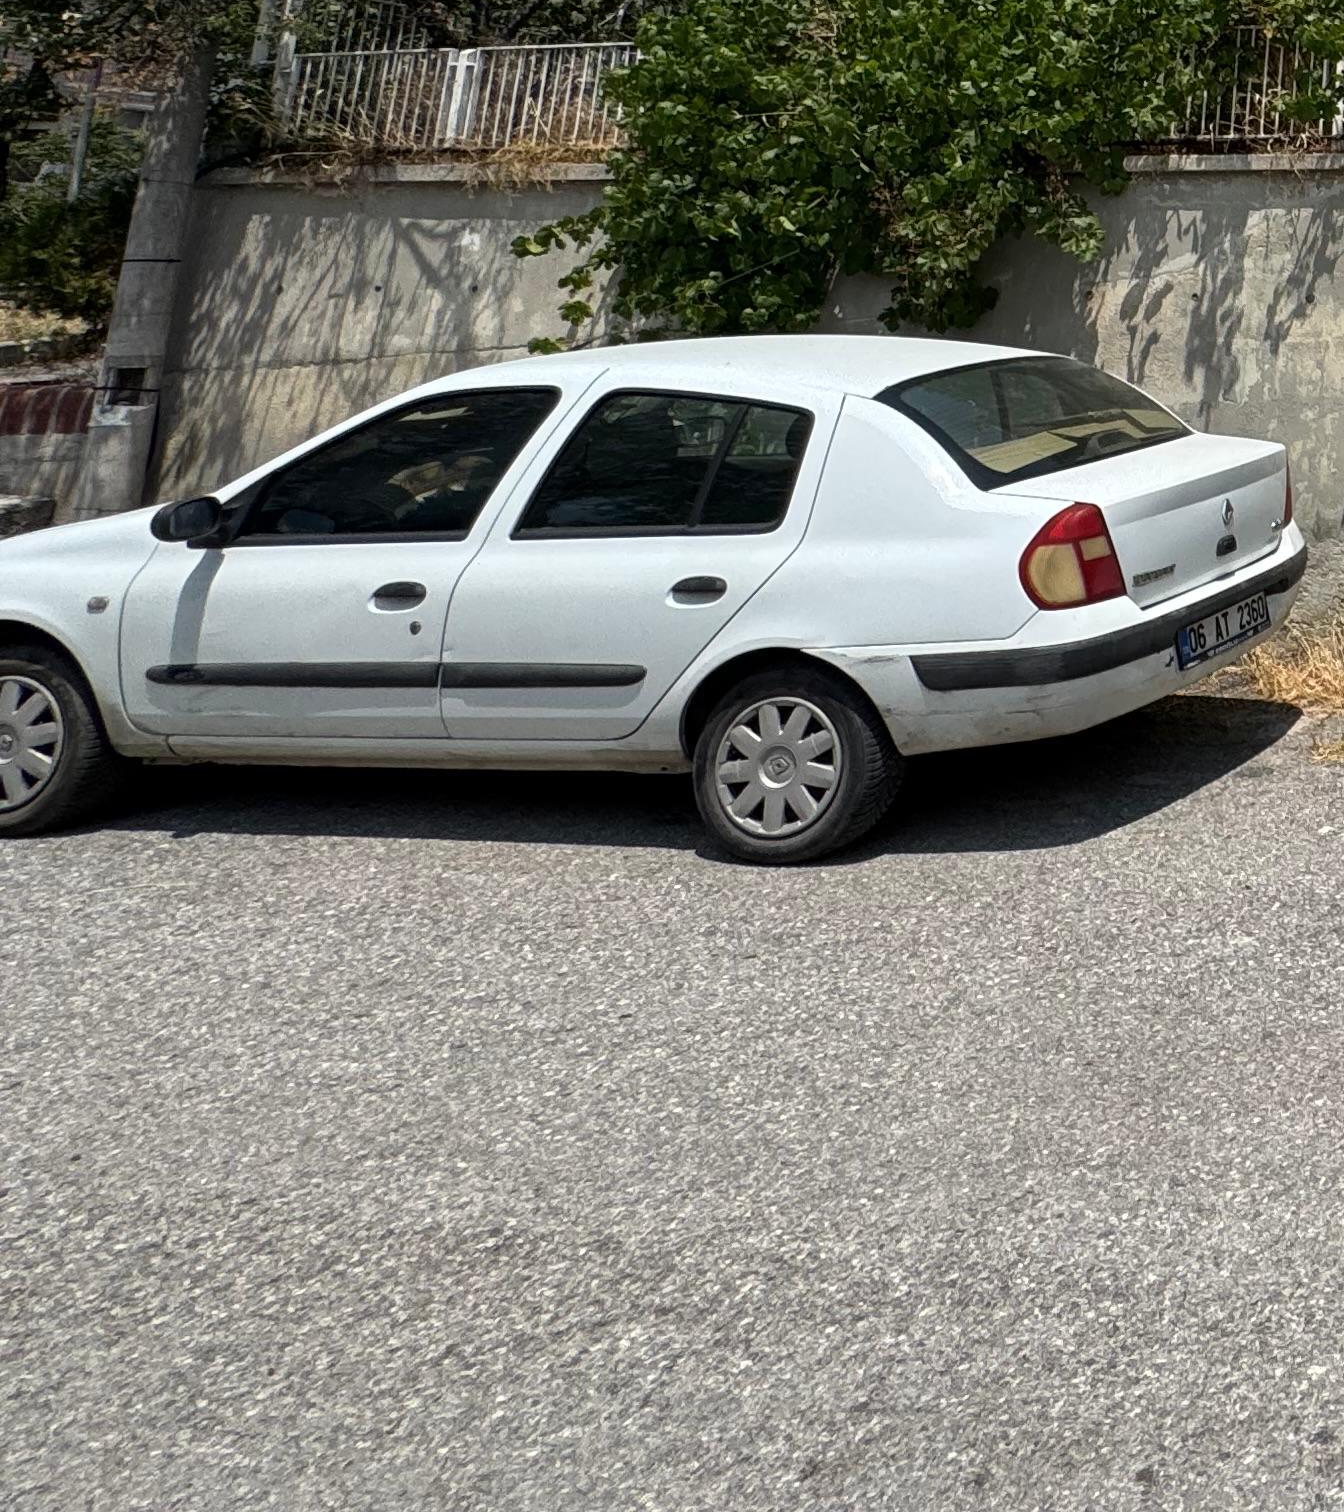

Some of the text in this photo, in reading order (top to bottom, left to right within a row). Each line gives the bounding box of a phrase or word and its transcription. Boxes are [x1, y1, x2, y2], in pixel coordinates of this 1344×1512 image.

[1188, 624, 1206, 653] 06
[1215, 611, 1230, 642] AT
[1237, 595, 1265, 631] 2360
